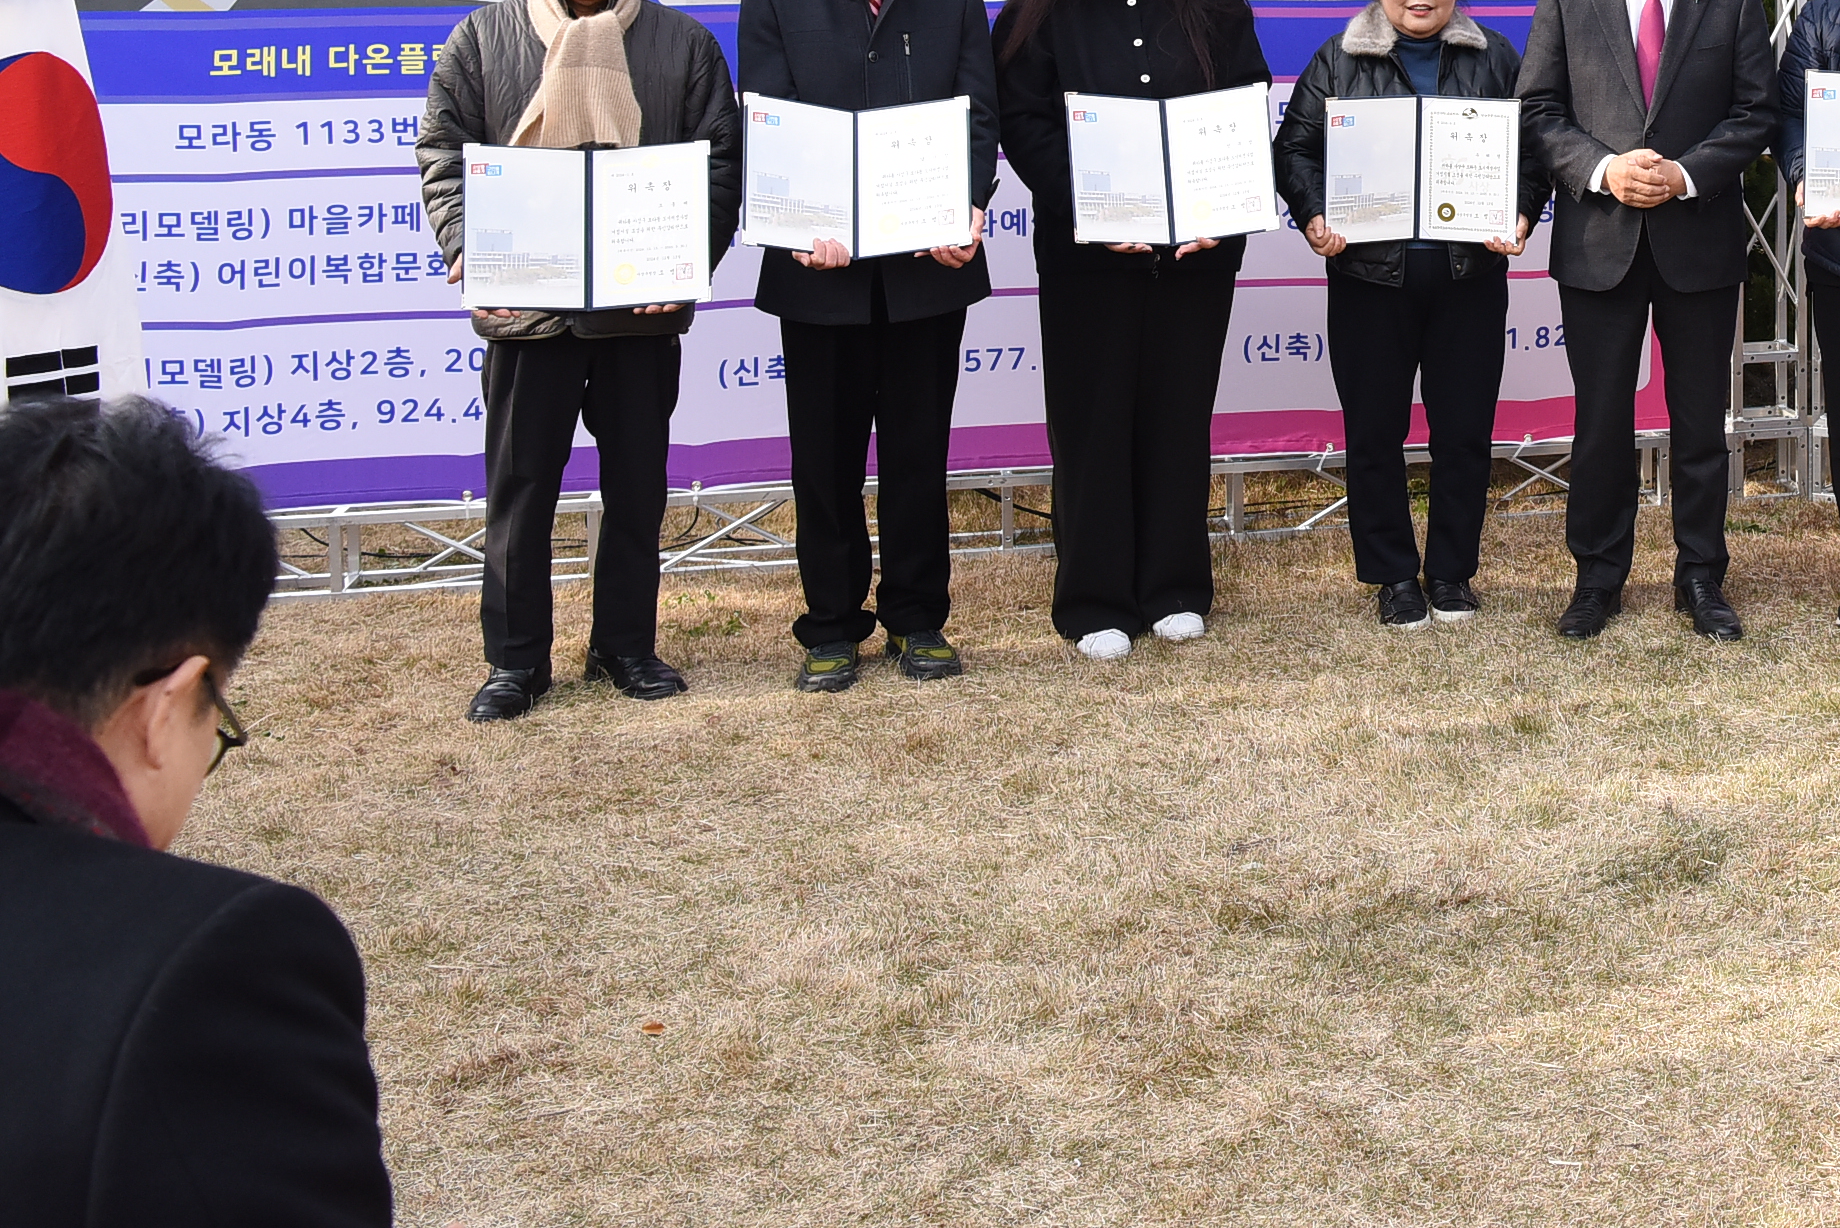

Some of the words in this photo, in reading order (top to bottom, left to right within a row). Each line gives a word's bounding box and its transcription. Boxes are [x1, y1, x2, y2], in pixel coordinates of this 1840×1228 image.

[209, 45, 311, 77] 모래내
[175, 120, 276, 152] 모라동
[288, 202, 421, 236] 마을카페
[291, 345, 427, 382] 지상2층,
[964, 347, 1037, 373] 577.
[1243, 333, 1324, 364] (신축)
[222, 399, 359, 438] 지상4층,
[376, 397, 485, 424] 924.4
